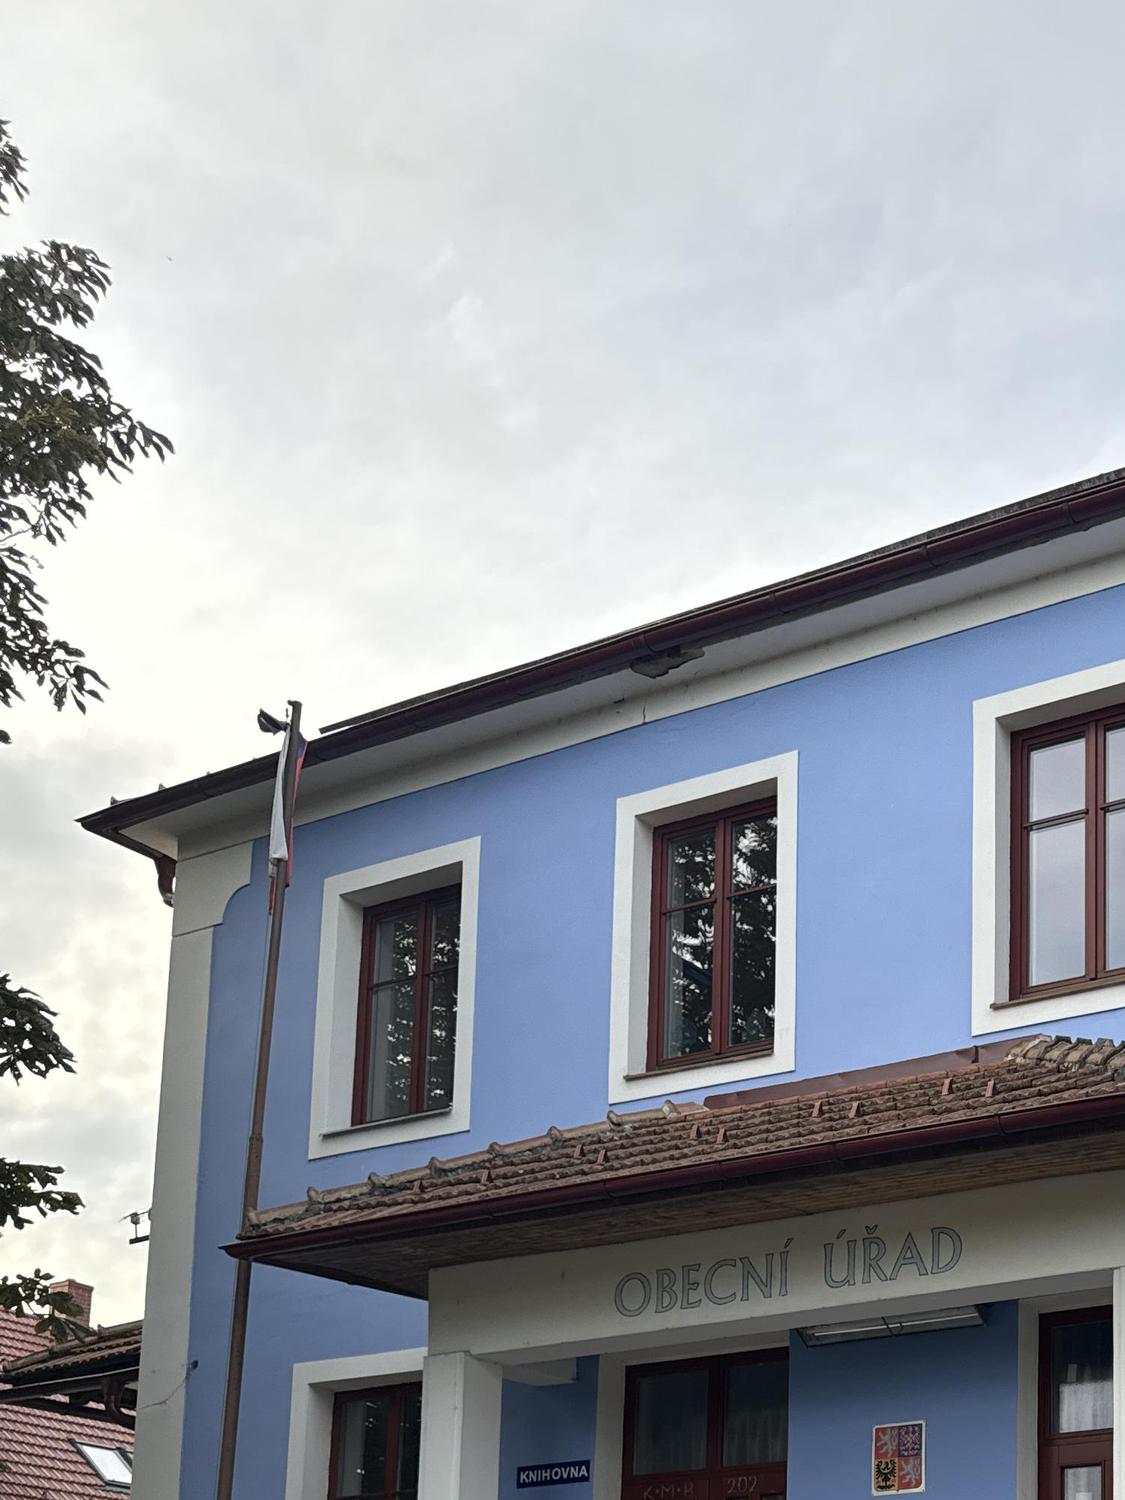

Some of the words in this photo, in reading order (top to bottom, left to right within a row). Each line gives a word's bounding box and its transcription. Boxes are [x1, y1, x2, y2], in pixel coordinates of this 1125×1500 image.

[615, 1238, 793, 1317] OBECNÍ
[824, 1225, 962, 1288] ÚŘAD
[520, 1465, 588, 1483] KNIHOVNA
